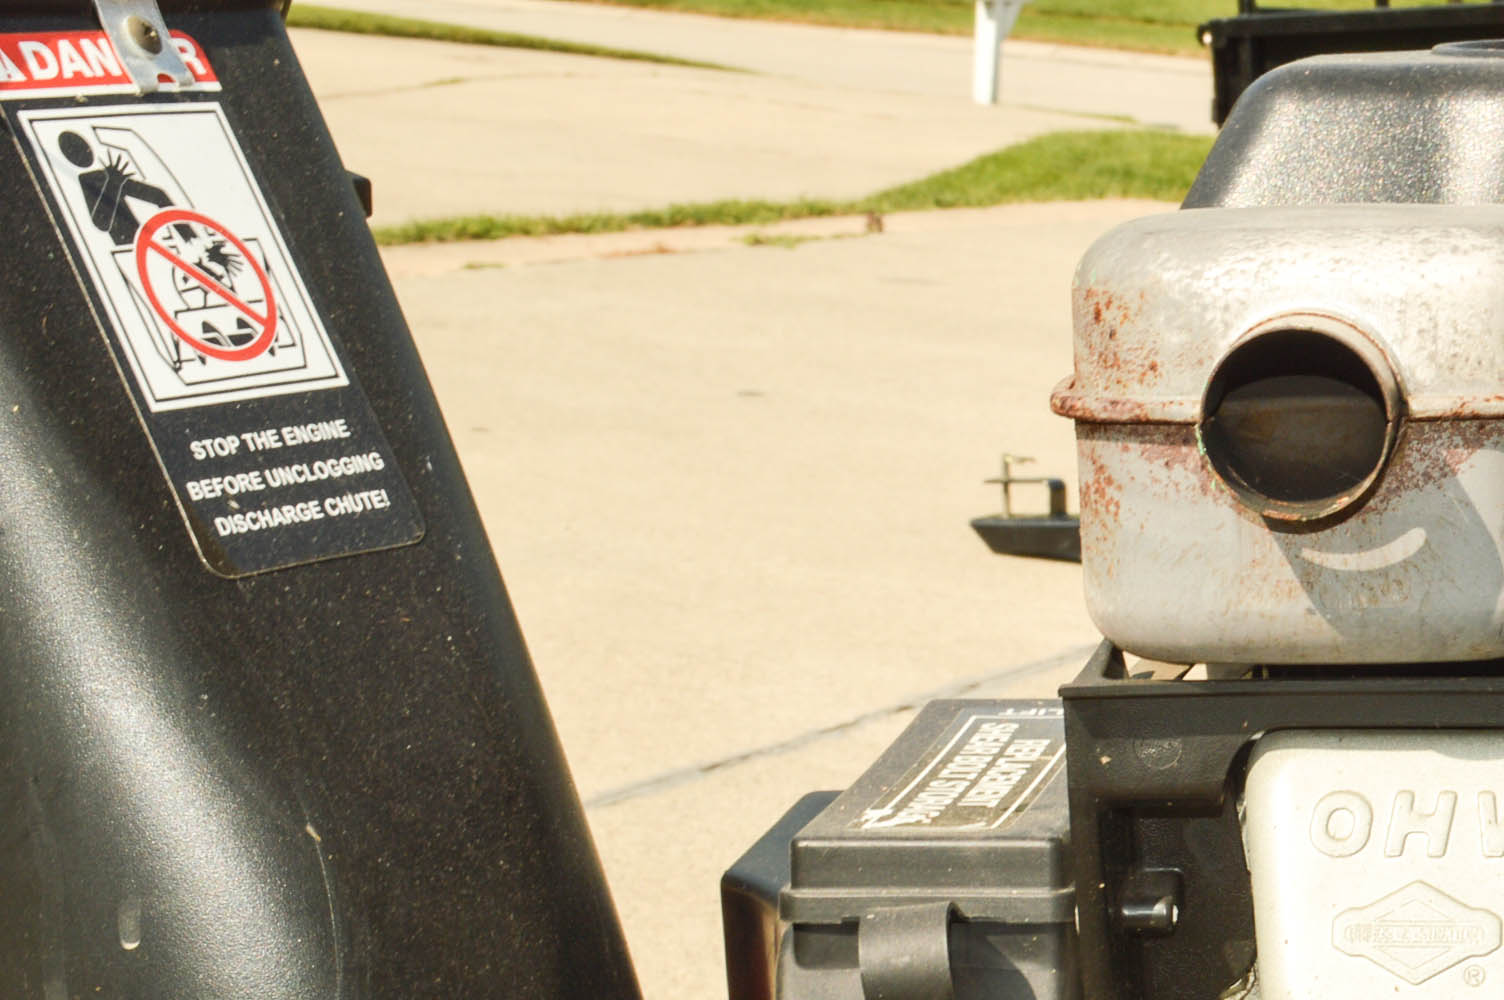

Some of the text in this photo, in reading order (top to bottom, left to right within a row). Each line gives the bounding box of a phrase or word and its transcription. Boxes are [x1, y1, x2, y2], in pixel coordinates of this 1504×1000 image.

[18, 37, 207, 80] DANR
[190, 419, 351, 461] STOP THE ENGINE
[186, 452, 385, 501] BEFORE UNCLOGGING
[214, 489, 391, 537] DISCHARGE CHUTE!
[897, 721, 1020, 824] SHEAR BOLT STORAGE
[956, 738, 1051, 808] REPLACEMENT
